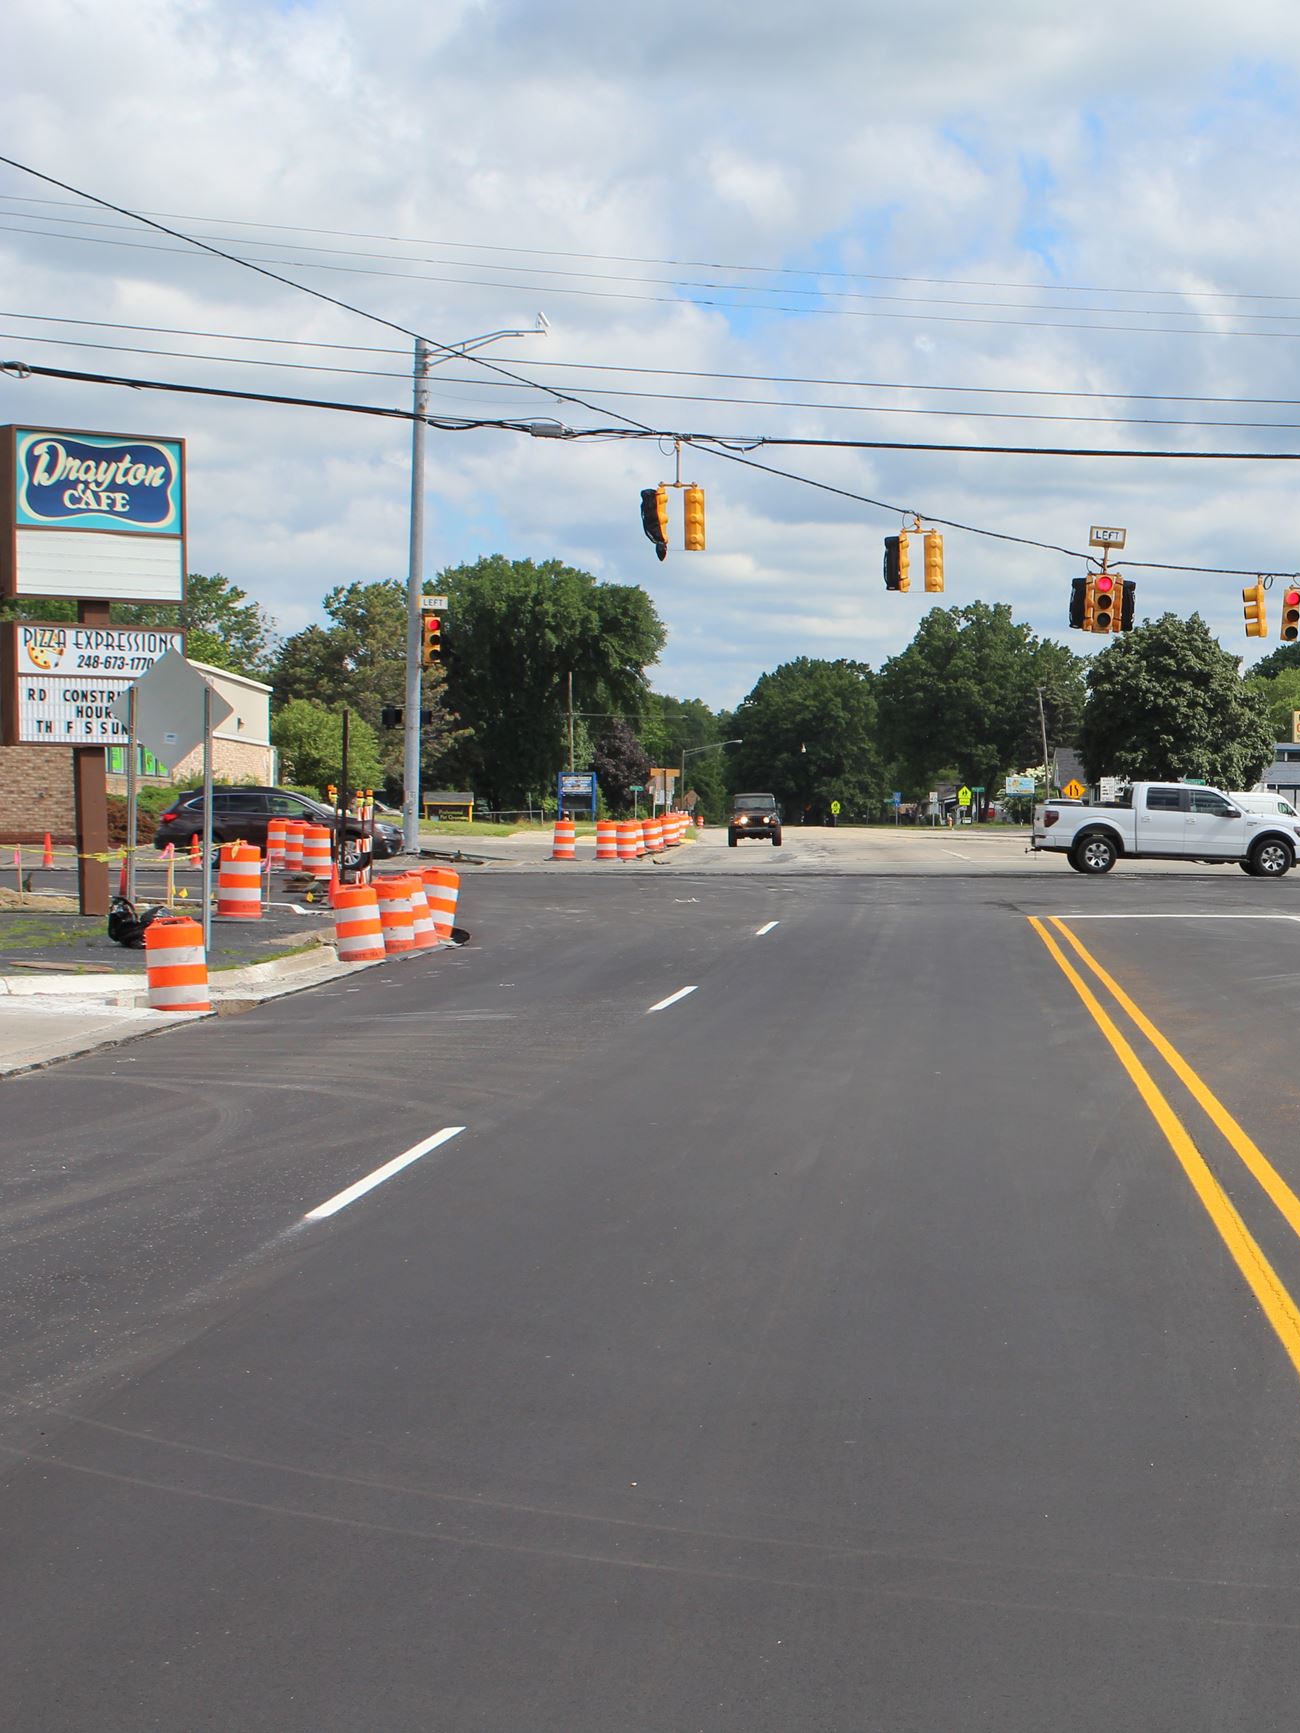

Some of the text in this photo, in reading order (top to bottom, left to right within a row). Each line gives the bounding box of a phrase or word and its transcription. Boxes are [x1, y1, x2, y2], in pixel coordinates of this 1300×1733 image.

[33, 441, 165, 491] Drayton
[63, 485, 130, 512] CAFE
[1095, 530, 1120, 541] LEFT
[24, 628, 66, 648] PIZZA
[28, 688, 47, 701] RD
[76, 705, 118, 719] HOUR
[37, 720, 52, 733] TH
[67, 721, 73, 734] F
[85, 721, 93, 734] S
